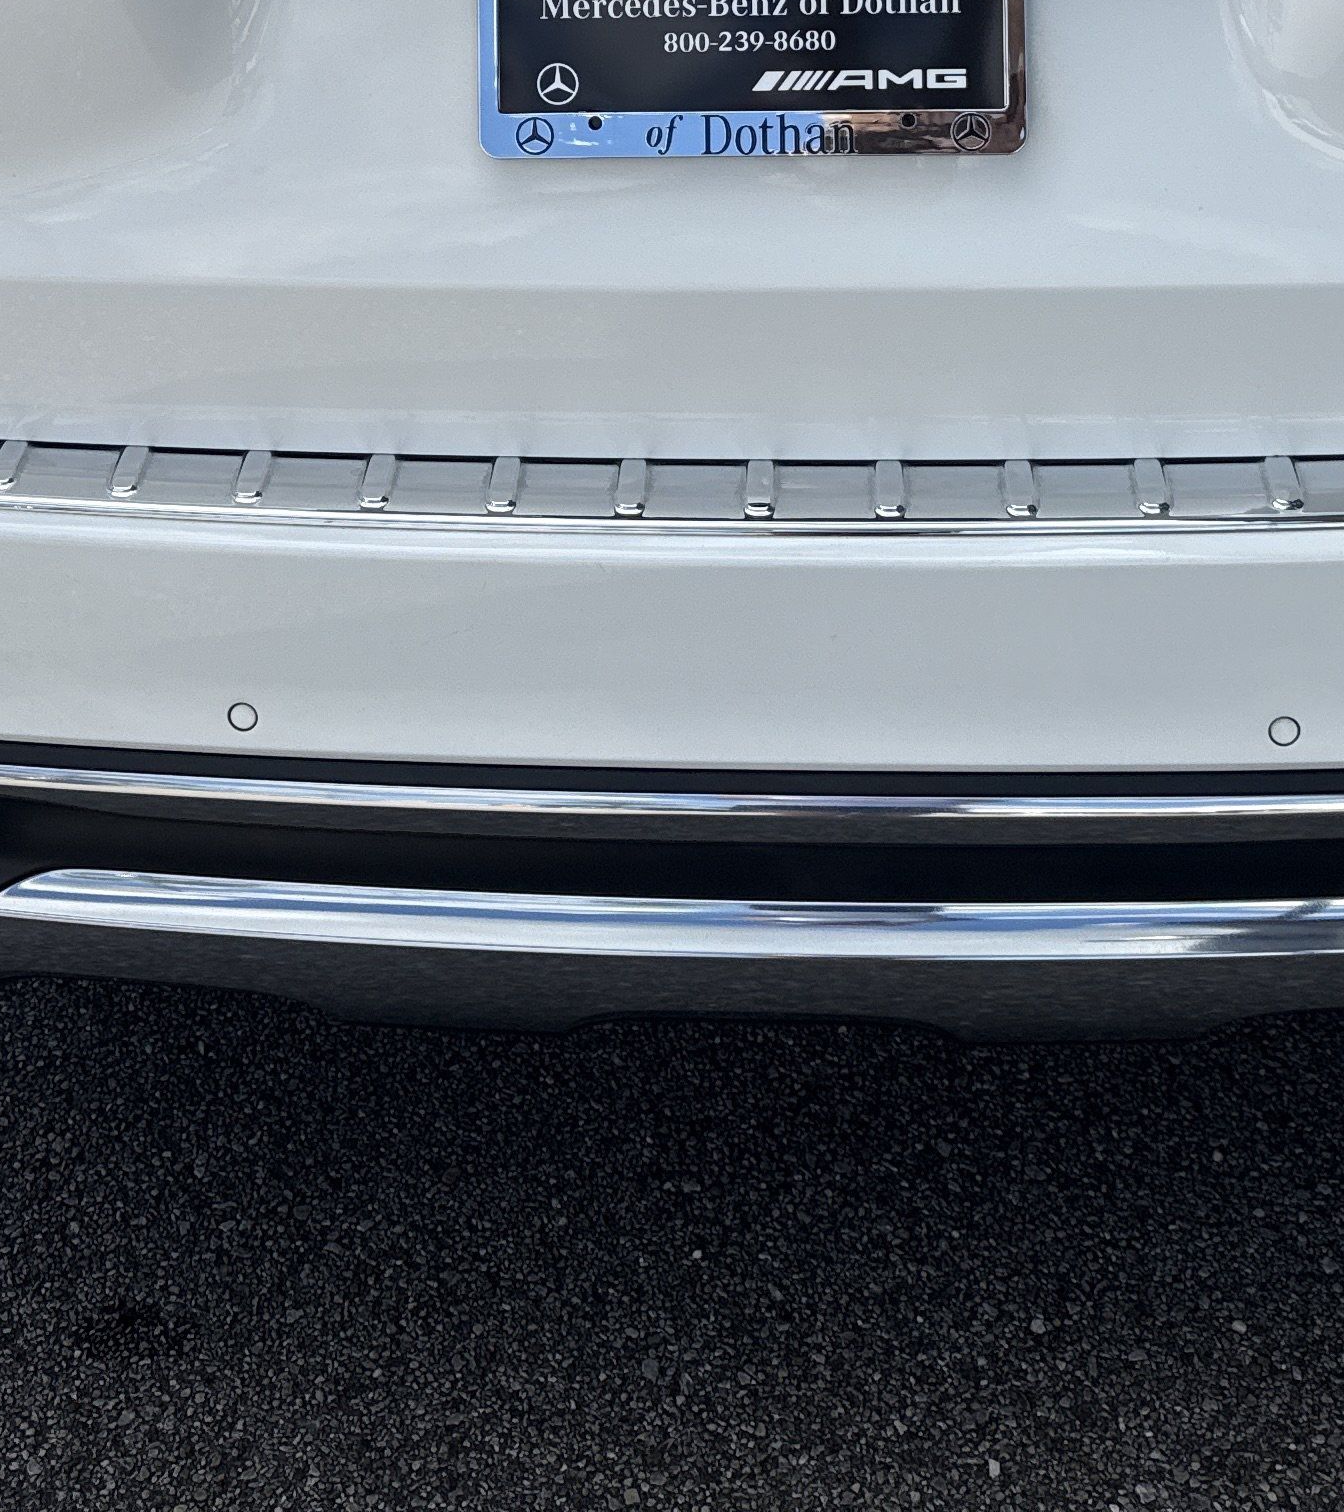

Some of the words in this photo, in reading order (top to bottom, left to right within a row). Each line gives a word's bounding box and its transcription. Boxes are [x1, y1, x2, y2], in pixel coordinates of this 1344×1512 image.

[663, 29, 836, 53] 800-239-8680
[645, 114, 684, 156] of
[701, 113, 859, 156] Dothan
